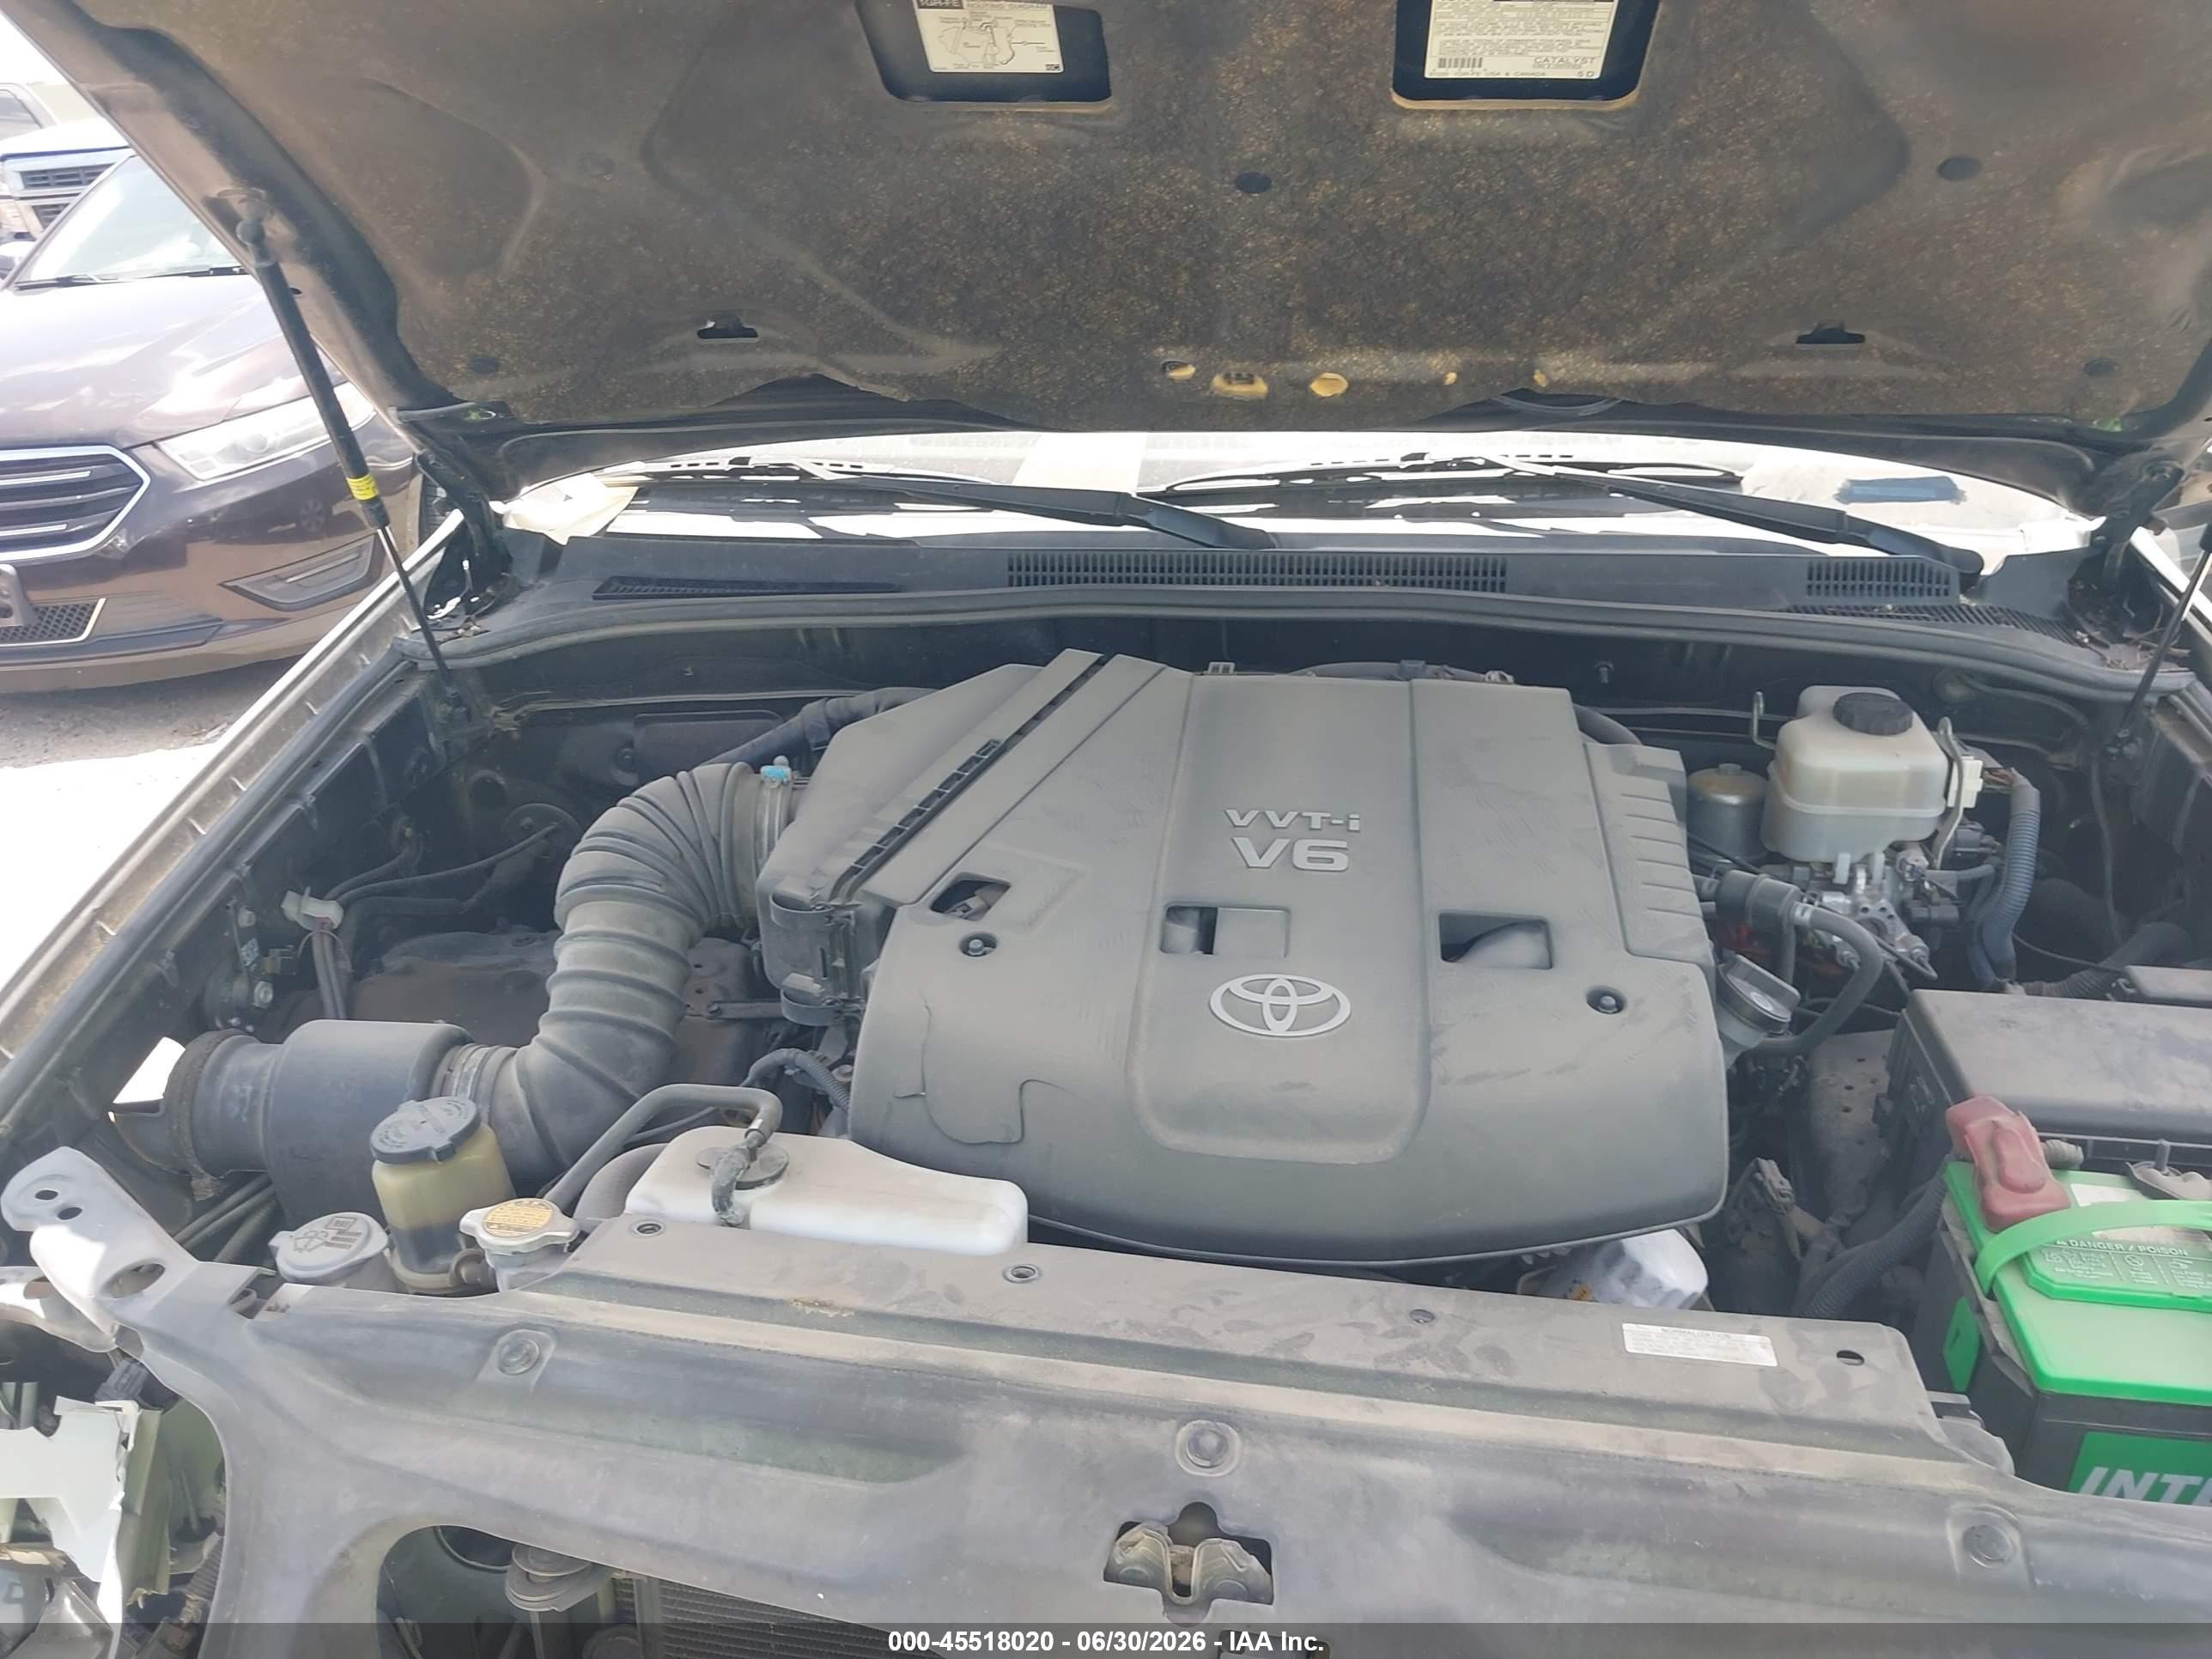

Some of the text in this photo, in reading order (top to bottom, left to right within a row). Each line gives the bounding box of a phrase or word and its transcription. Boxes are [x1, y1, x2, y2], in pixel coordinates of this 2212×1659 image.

[1224, 808, 1362, 832] VVT-i
[1231, 836, 1350, 872] V6
[2068, 1239, 2124, 1251] DANGER
[2137, 1245, 2189, 1256] POISON
